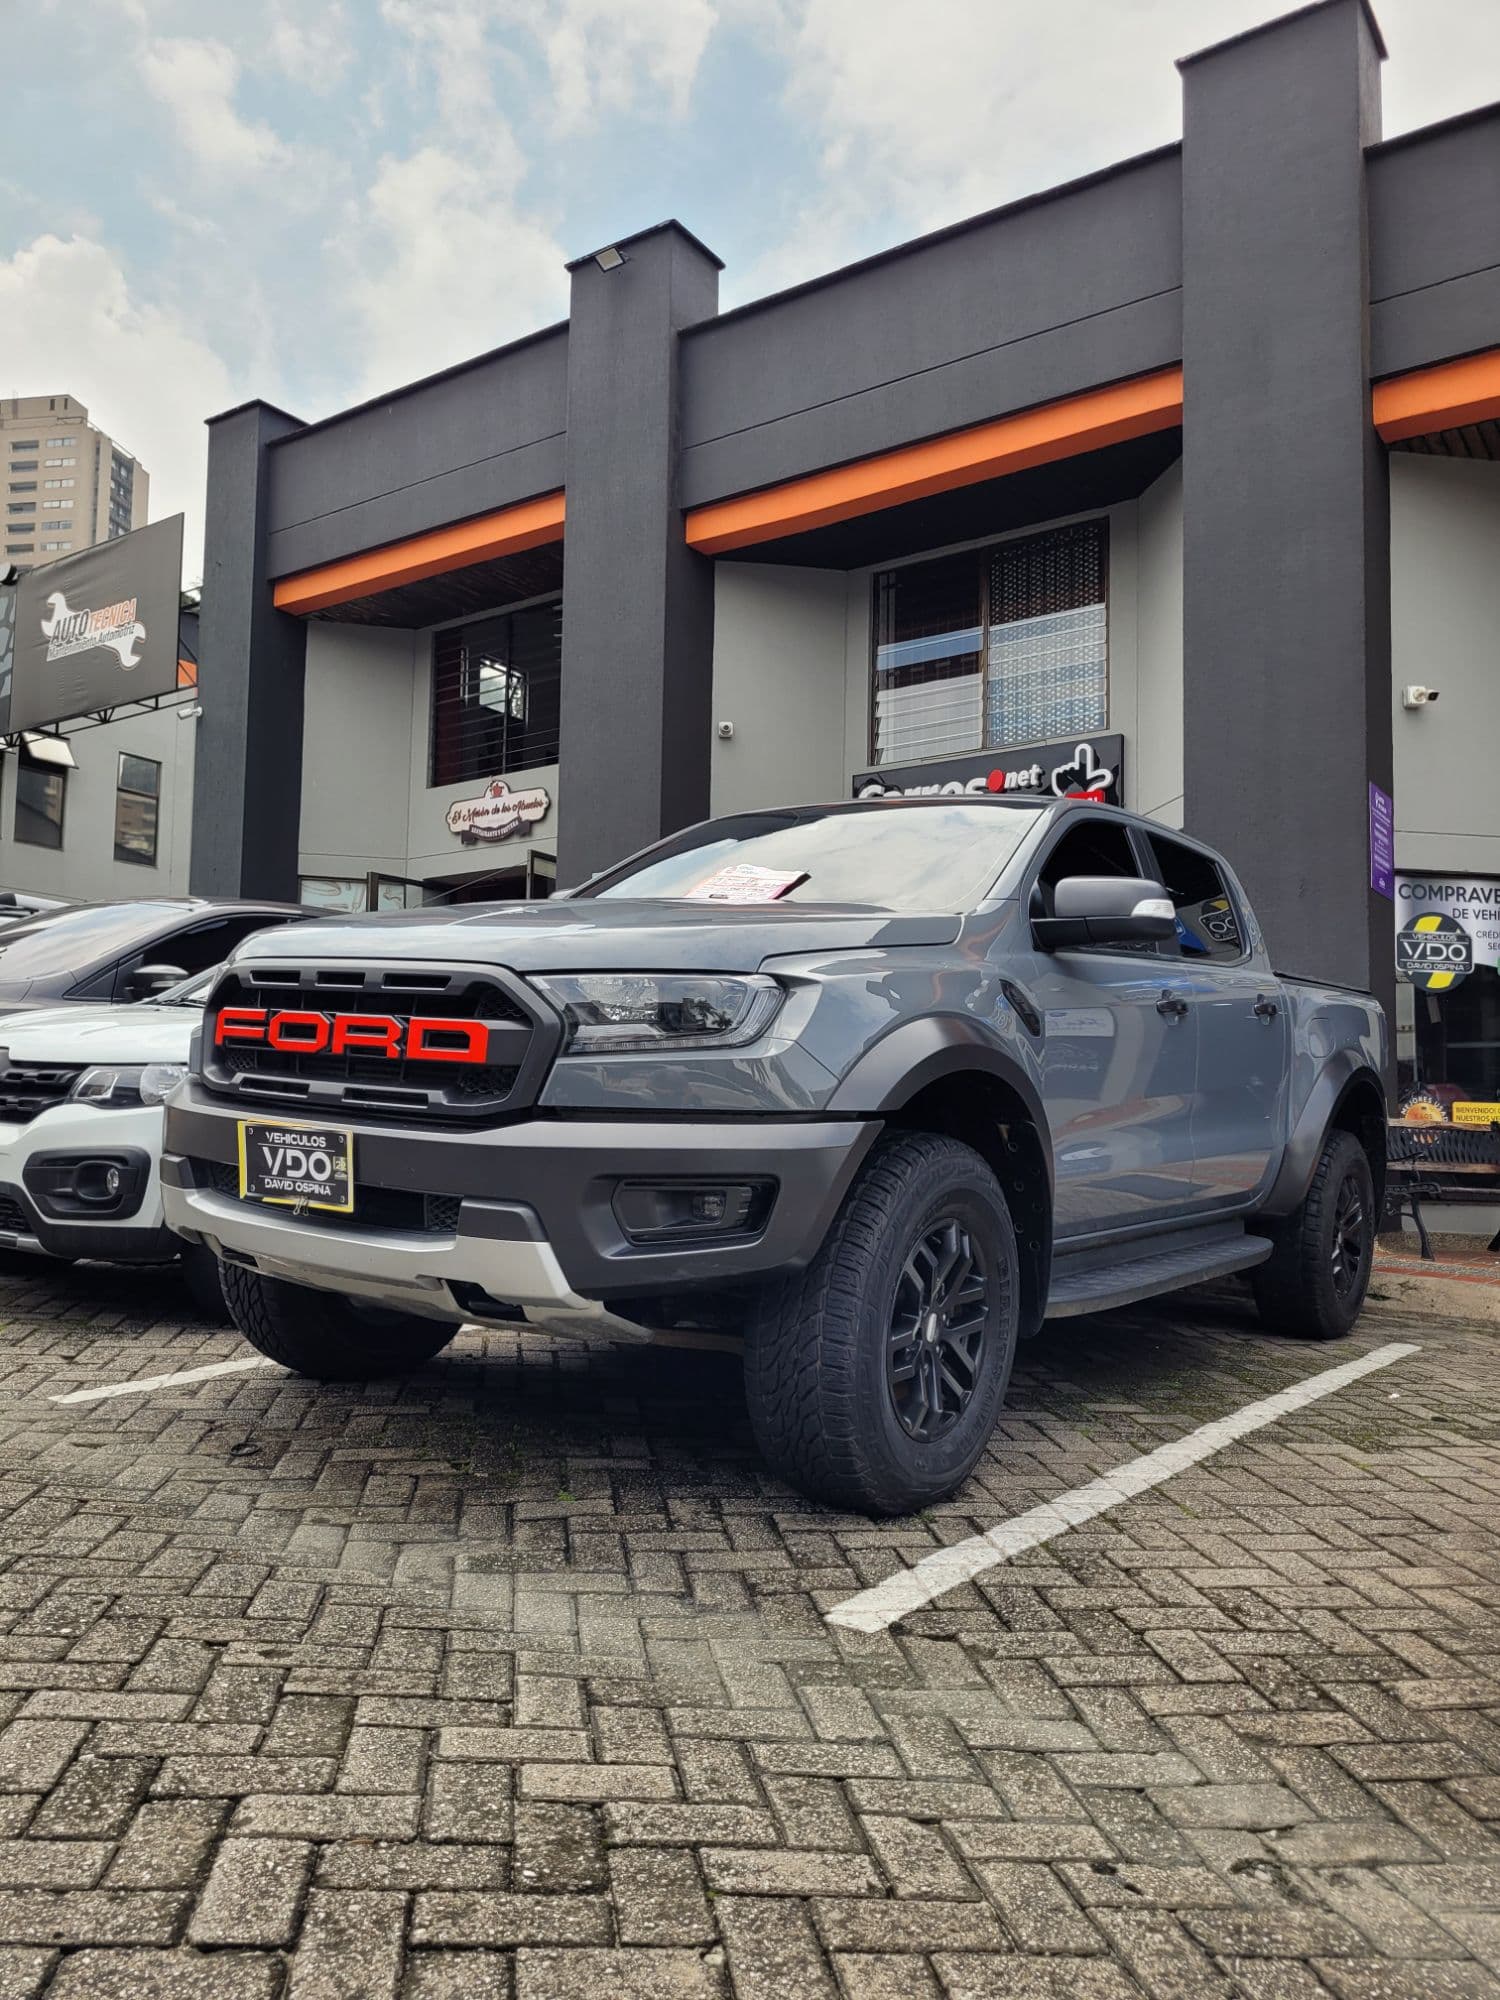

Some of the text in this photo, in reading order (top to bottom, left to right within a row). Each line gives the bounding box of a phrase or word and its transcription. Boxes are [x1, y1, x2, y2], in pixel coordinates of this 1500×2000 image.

[451, 808, 462, 825] El
[491, 803, 500, 815] de
[501, 802, 512, 813] los
[512, 797, 544, 817] Abuelos
[1452, 908, 1469, 920] DE
[1411, 932, 1457, 942] VEHICULOS
[1403, 941, 1467, 961] VDO
[1433, 963, 1465, 971] OSPINA
[215, 1006, 490, 1063] FORD
[265, 1131, 327, 1148] VEHICULOS
[262, 1146, 332, 1181] VDO
[264, 1178, 332, 1196] DAVID OSPINA
